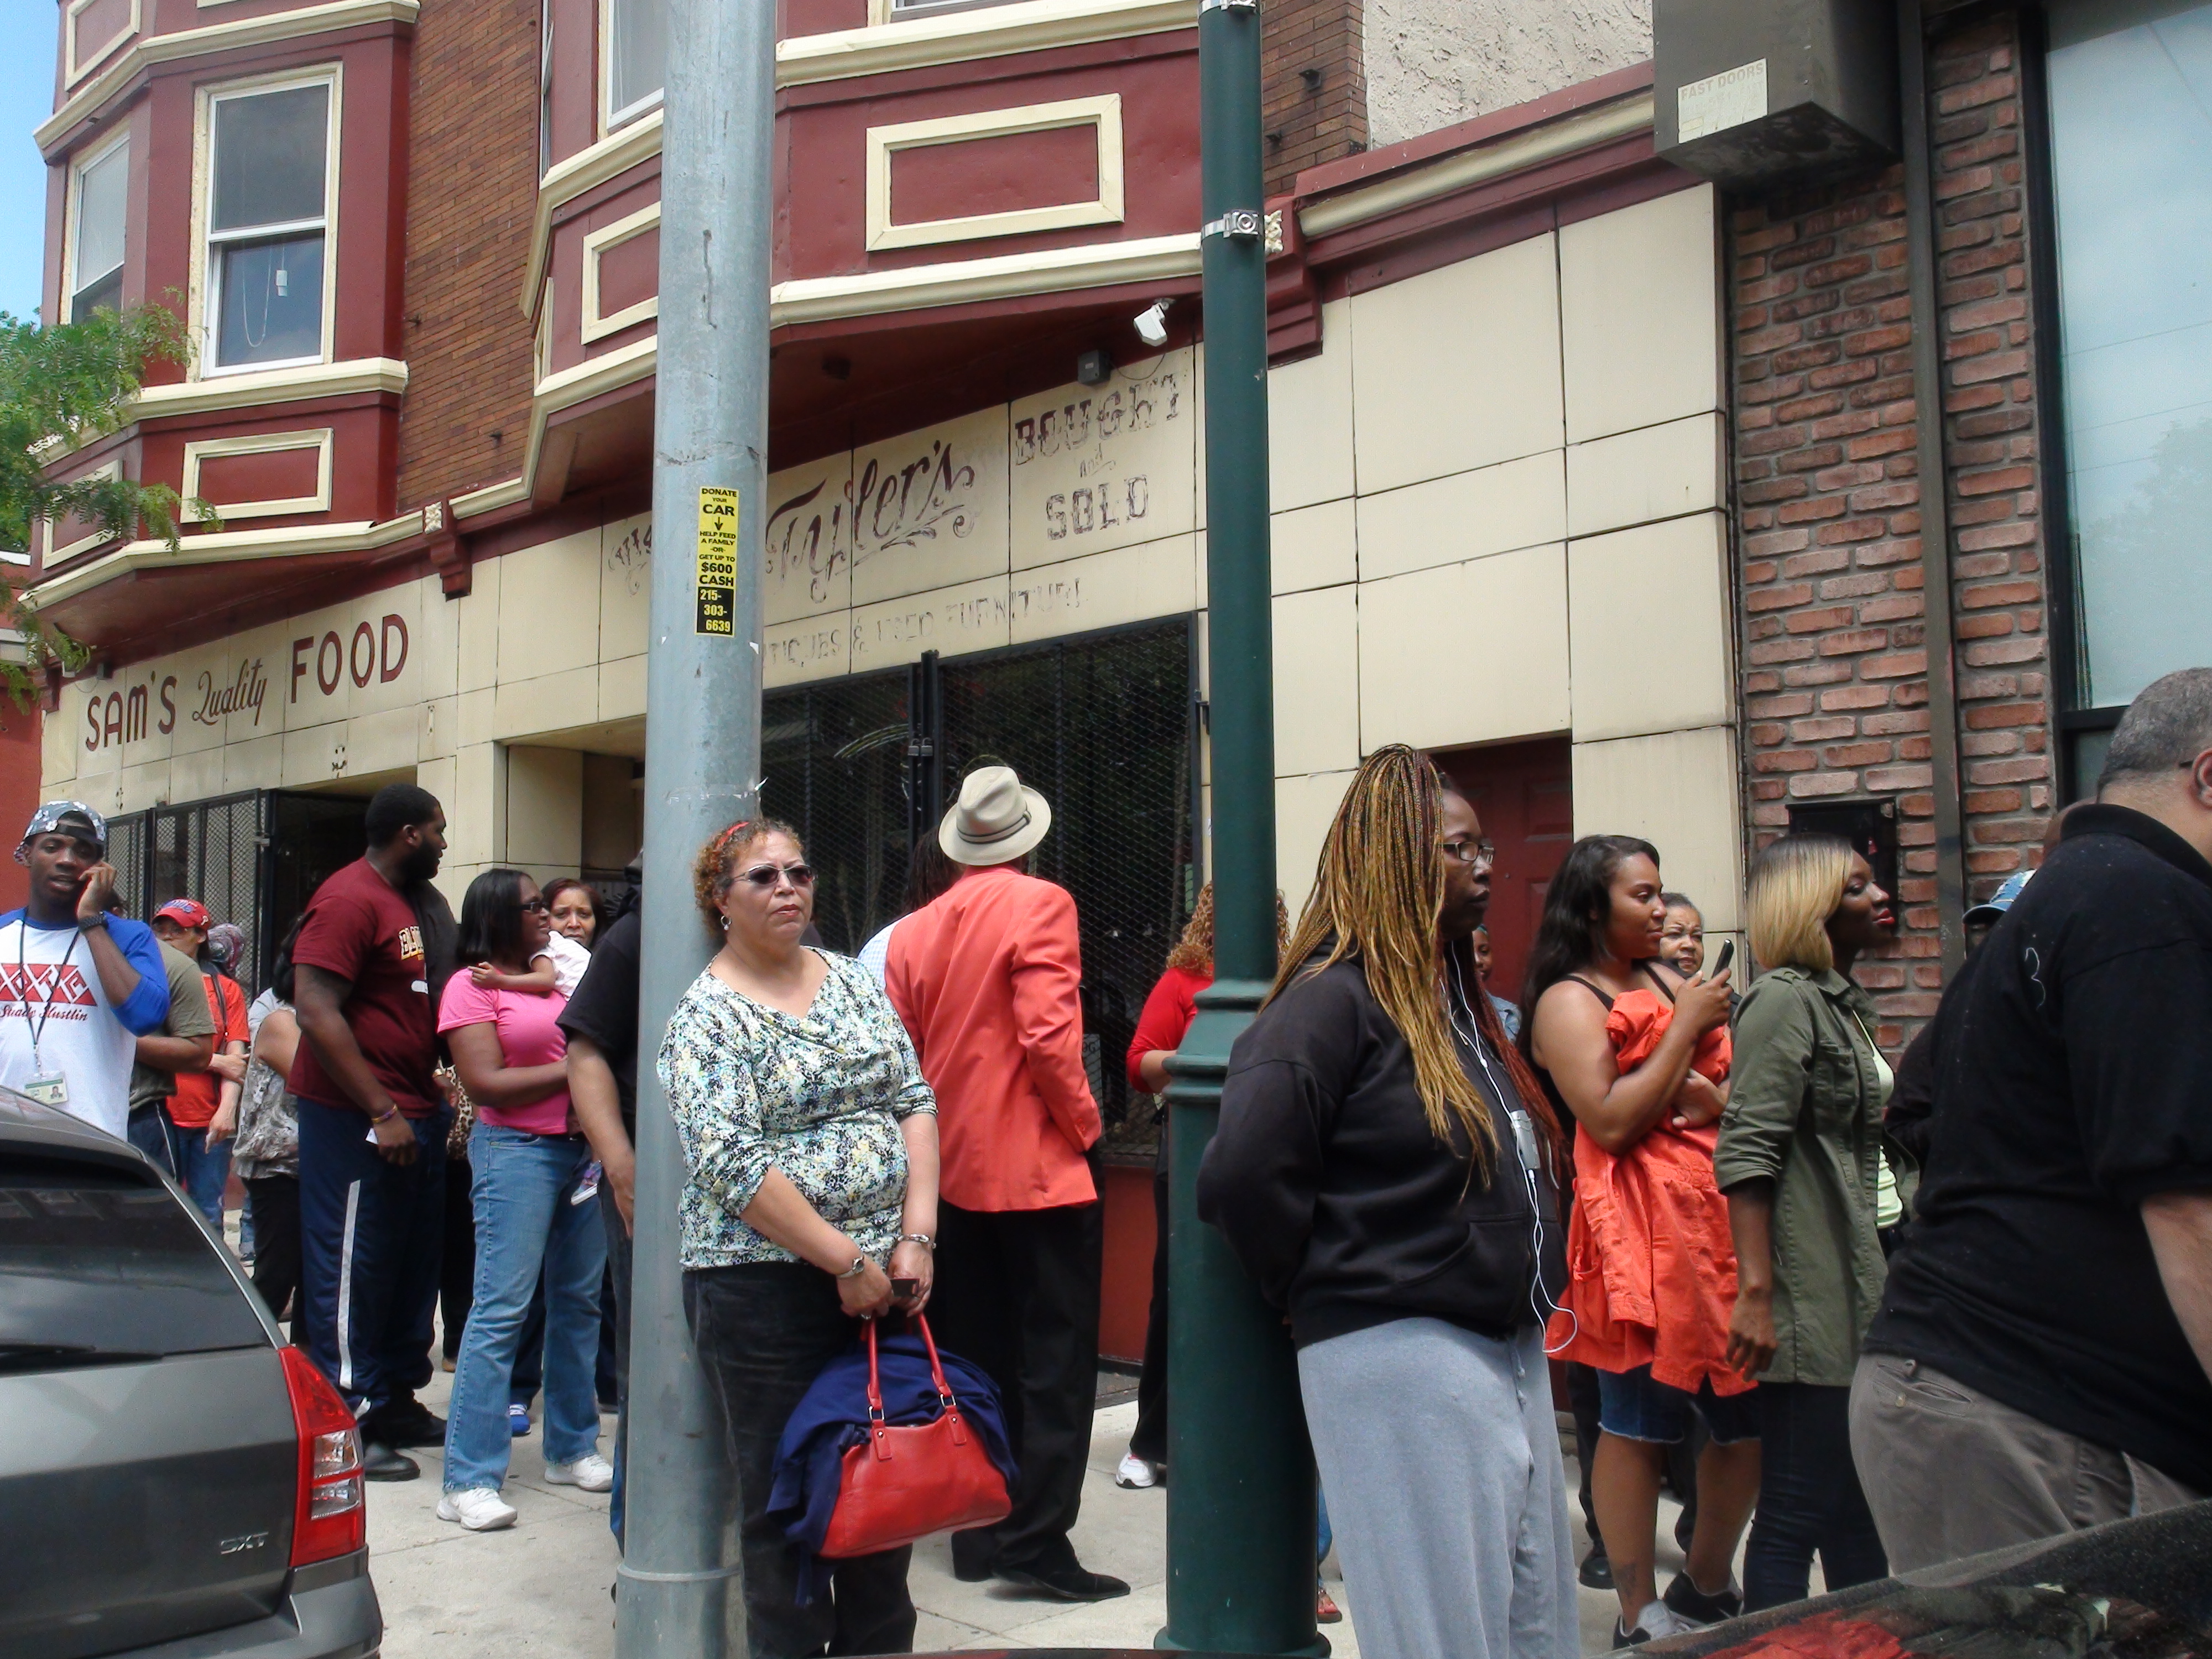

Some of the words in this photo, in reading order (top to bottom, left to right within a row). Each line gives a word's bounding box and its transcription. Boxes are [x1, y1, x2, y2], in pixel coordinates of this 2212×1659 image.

[1681, 80, 1714, 101] FAST
[1718, 64, 1763, 88] DOORS
[702, 488, 737, 497] DONATE
[703, 504, 735, 517] CAR
[1046, 474, 1148, 540] SOLD
[701, 561, 733, 573] $600
[699, 575, 734, 586] CASH
[700, 588, 722, 601] 215-
[703, 604, 727, 616] 303-
[706, 619, 731, 632] 6639
[86, 670, 177, 751] SAM'S
[192, 658, 268, 726] Quality
[291, 614, 408, 703] FOOD
